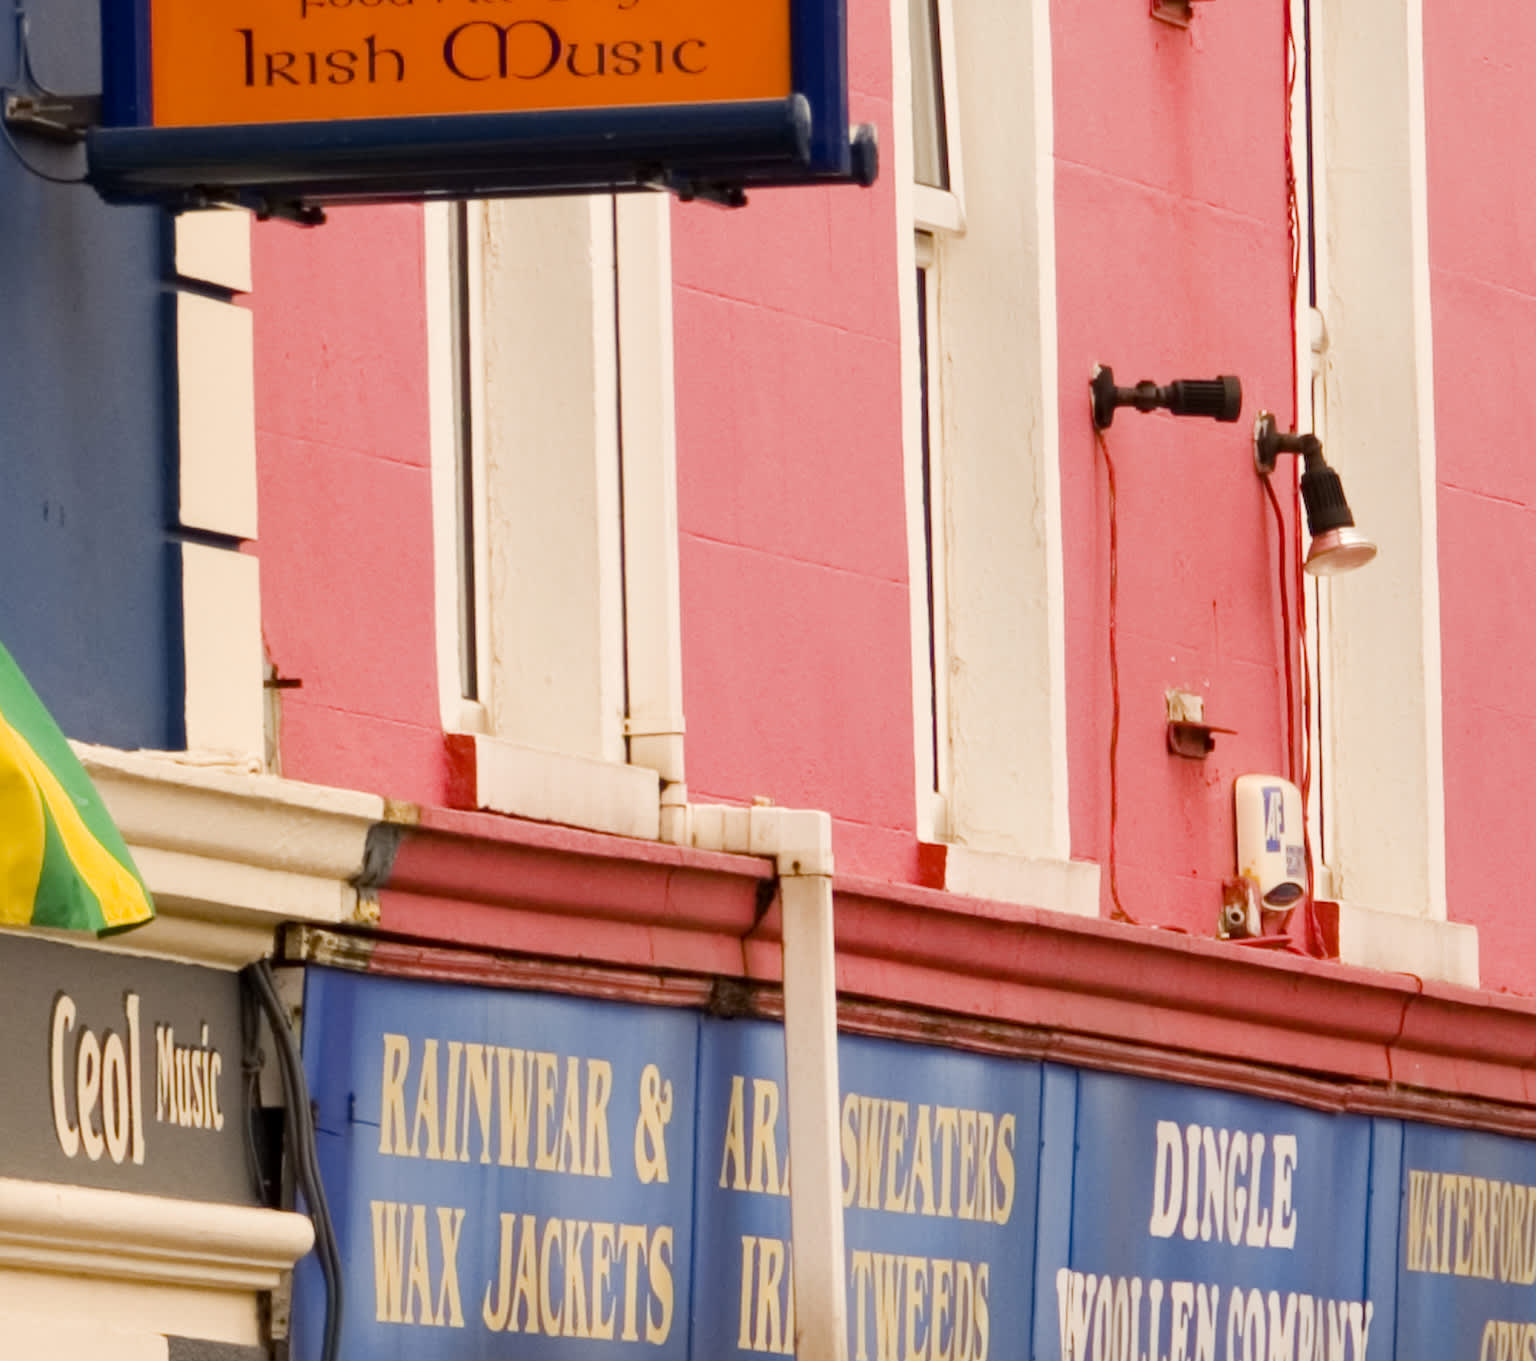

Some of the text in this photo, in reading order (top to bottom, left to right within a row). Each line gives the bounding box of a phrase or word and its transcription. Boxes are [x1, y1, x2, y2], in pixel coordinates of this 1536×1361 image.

[232, 18, 708, 88] Irish Music
[48, 991, 146, 1166] Ceol
[153, 1020, 225, 1133] Music
[378, 1033, 674, 1185] RAINWEAR &
[839, 1092, 1016, 1226] SWEATERS
[1148, 1120, 1299, 1251] DINGLE
[369, 1200, 675, 1347] WAX JACKETS
